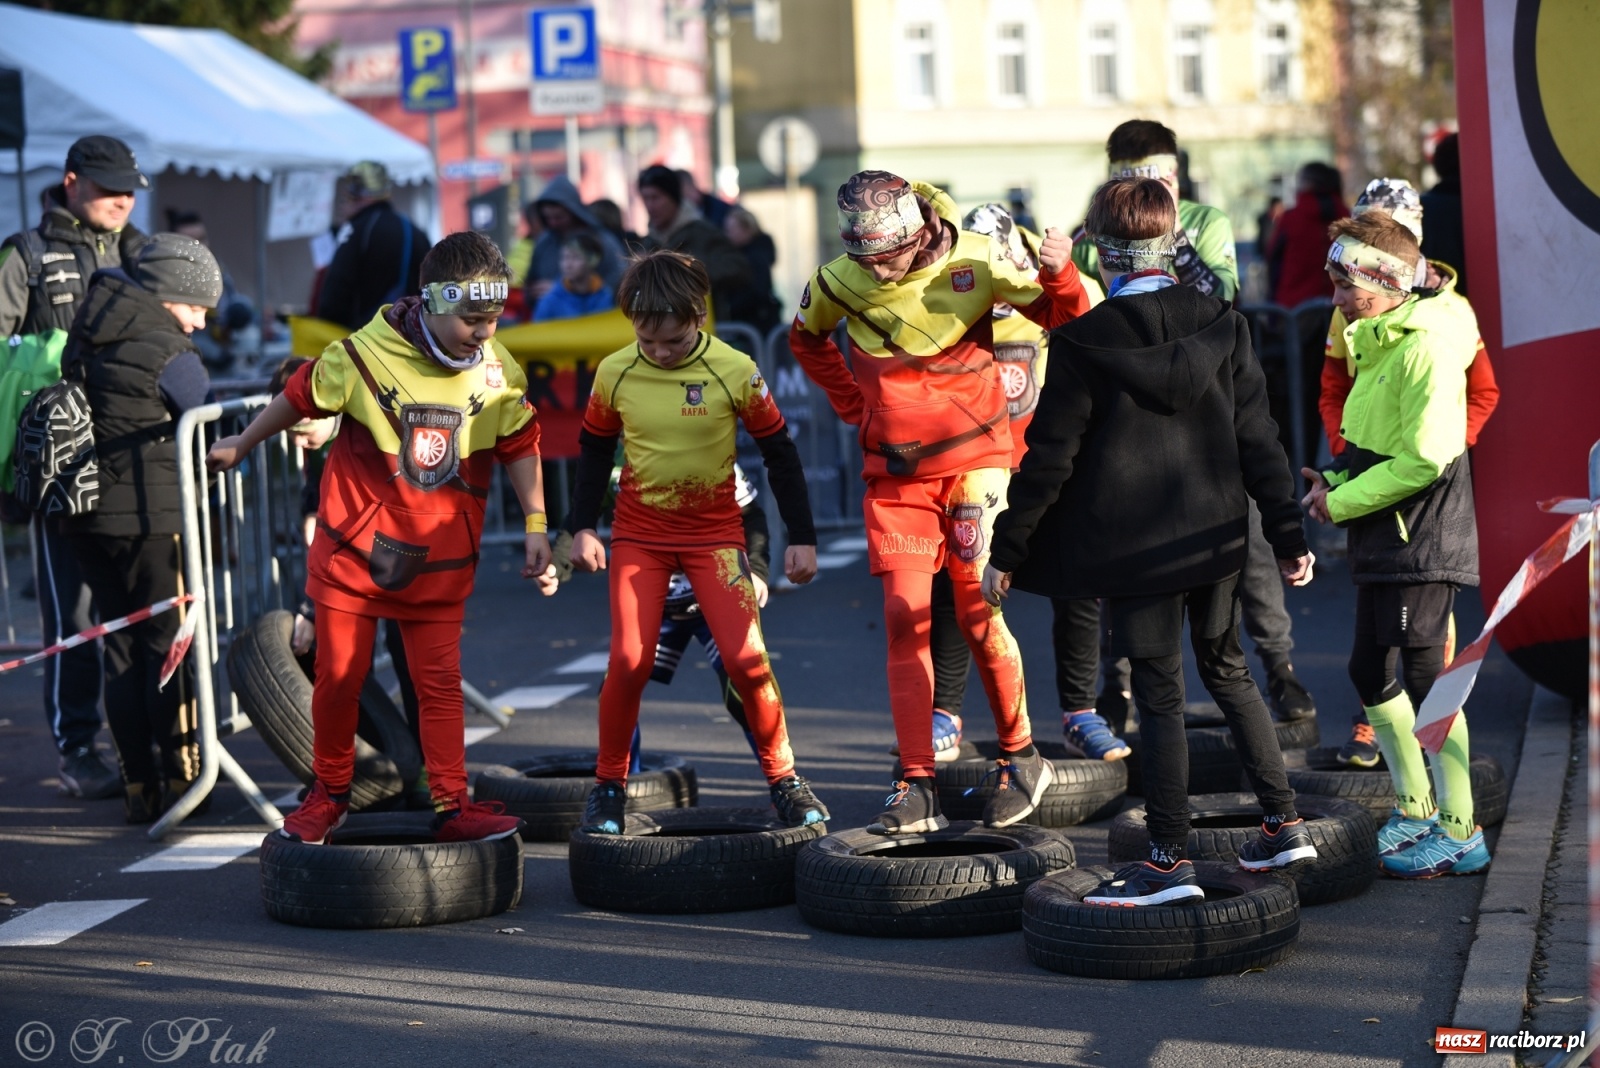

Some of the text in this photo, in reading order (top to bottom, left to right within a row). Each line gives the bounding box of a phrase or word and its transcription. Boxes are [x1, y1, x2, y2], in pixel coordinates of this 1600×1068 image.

[411, 30, 444, 70] P
[541, 13, 587, 75] P
[681, 407, 709, 416] RAFAŁ
[420, 471, 436, 483] OCR
[1151, 854, 1179, 864] DAY
